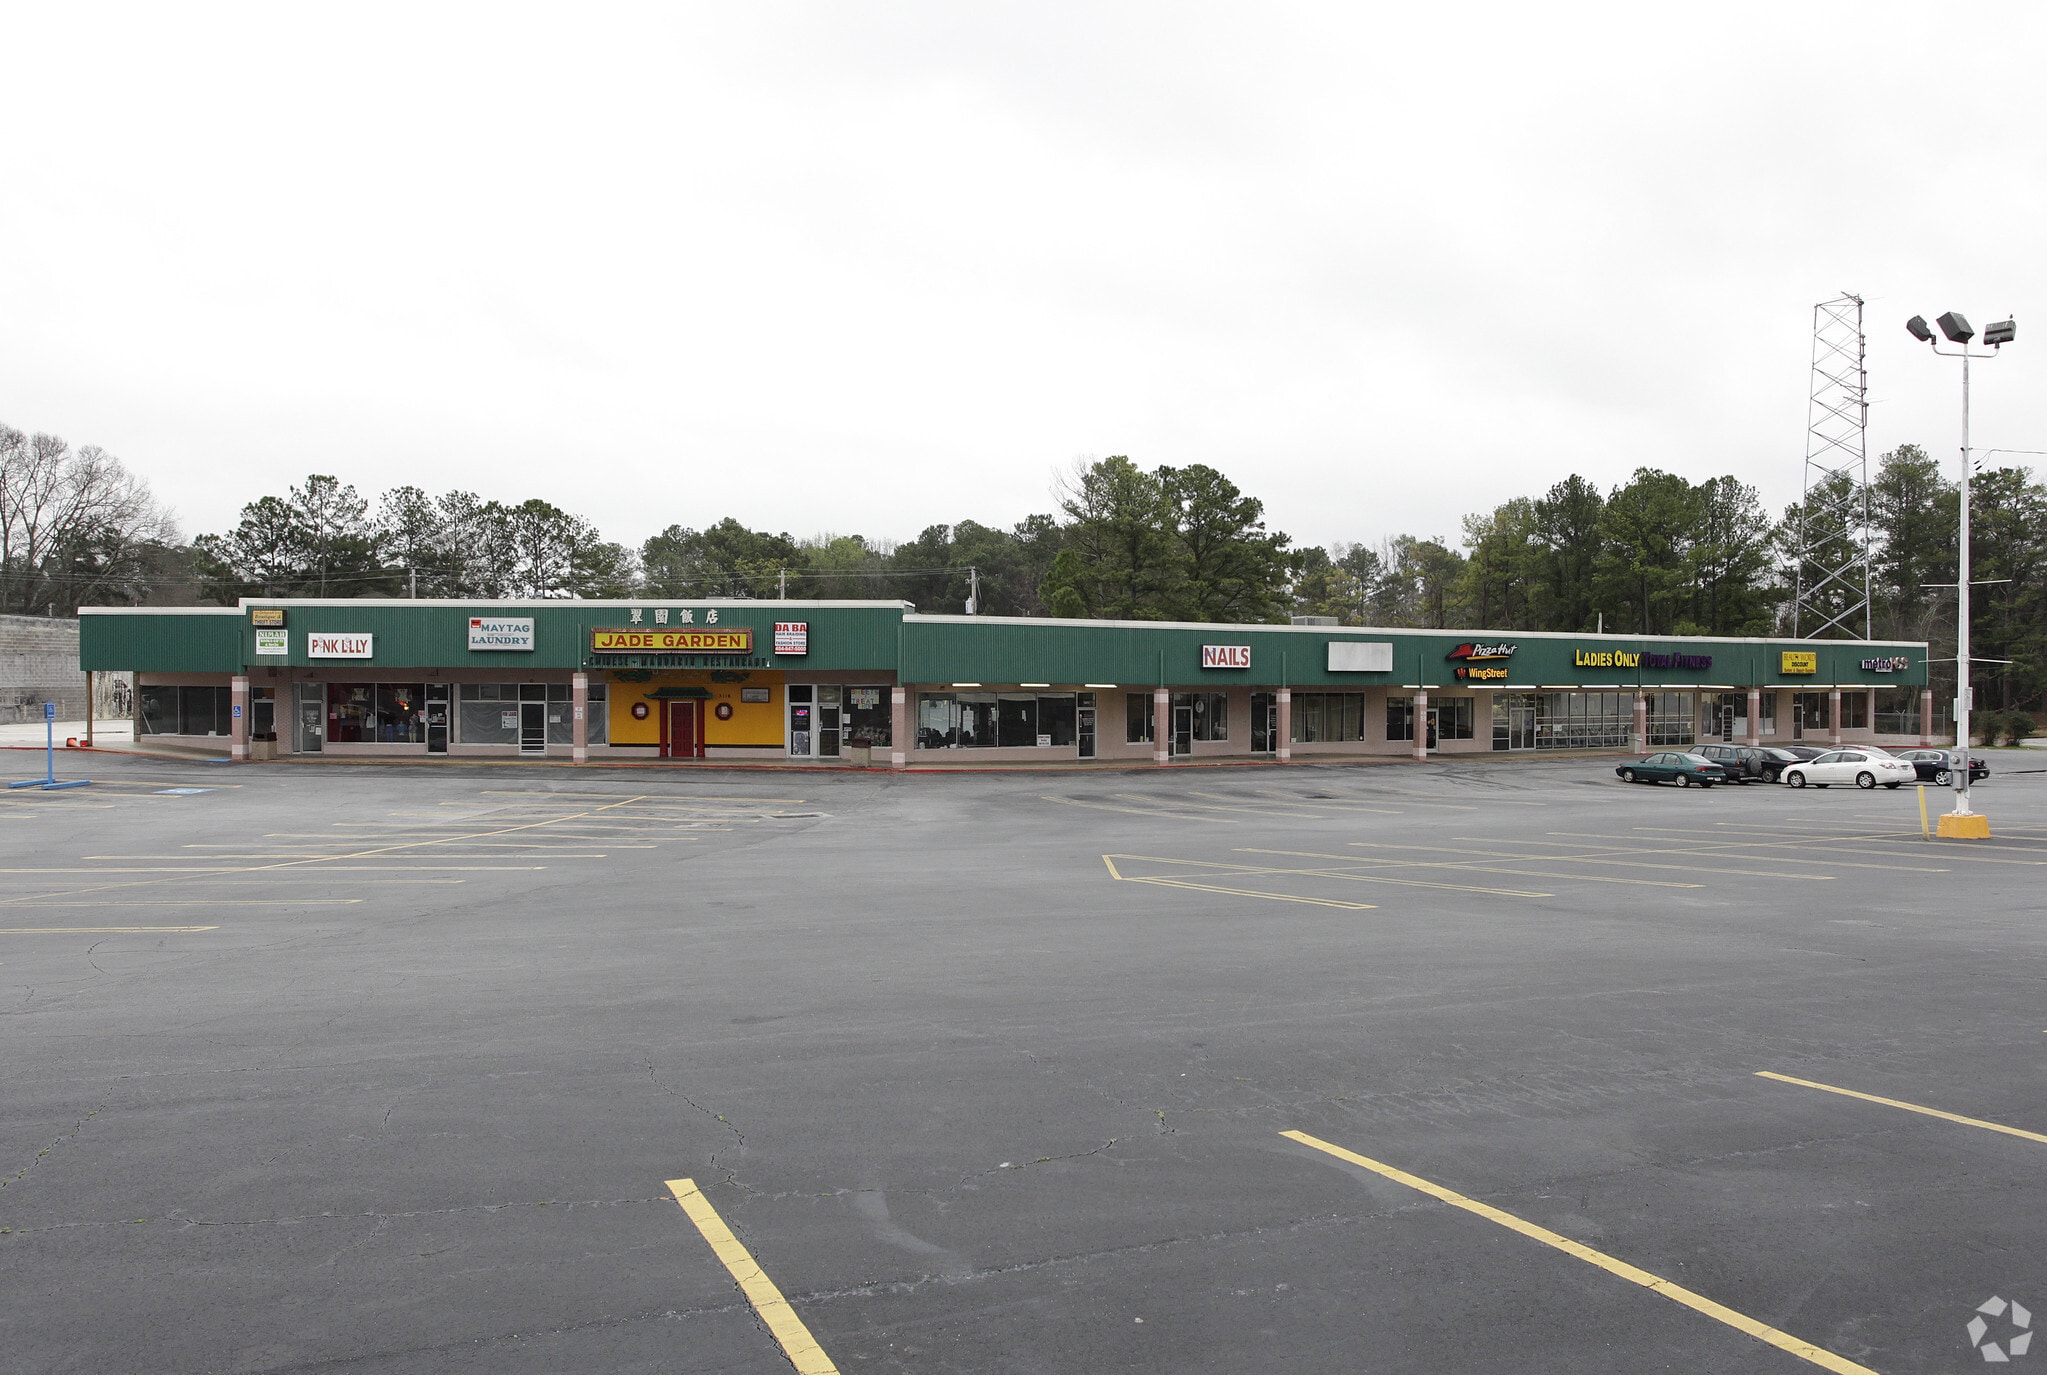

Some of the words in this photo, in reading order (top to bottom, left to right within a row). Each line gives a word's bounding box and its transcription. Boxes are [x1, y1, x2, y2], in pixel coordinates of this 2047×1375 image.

[481, 624, 530, 632] MAYTAG
[471, 636, 530, 645] LAUNDRY
[601, 634, 654, 647] JADE
[662, 634, 741, 647] GARDEN
[1472, 644, 1497, 656] Pizza
[1498, 643, 1517, 654] Hut
[589, 656, 629, 666] CHINESE
[1204, 648, 1249, 666] NAILS
[1575, 649, 1613, 666] LADIES
[1614, 650, 1640, 667] ONLY
[1468, 667, 1508, 680] WingStreet
